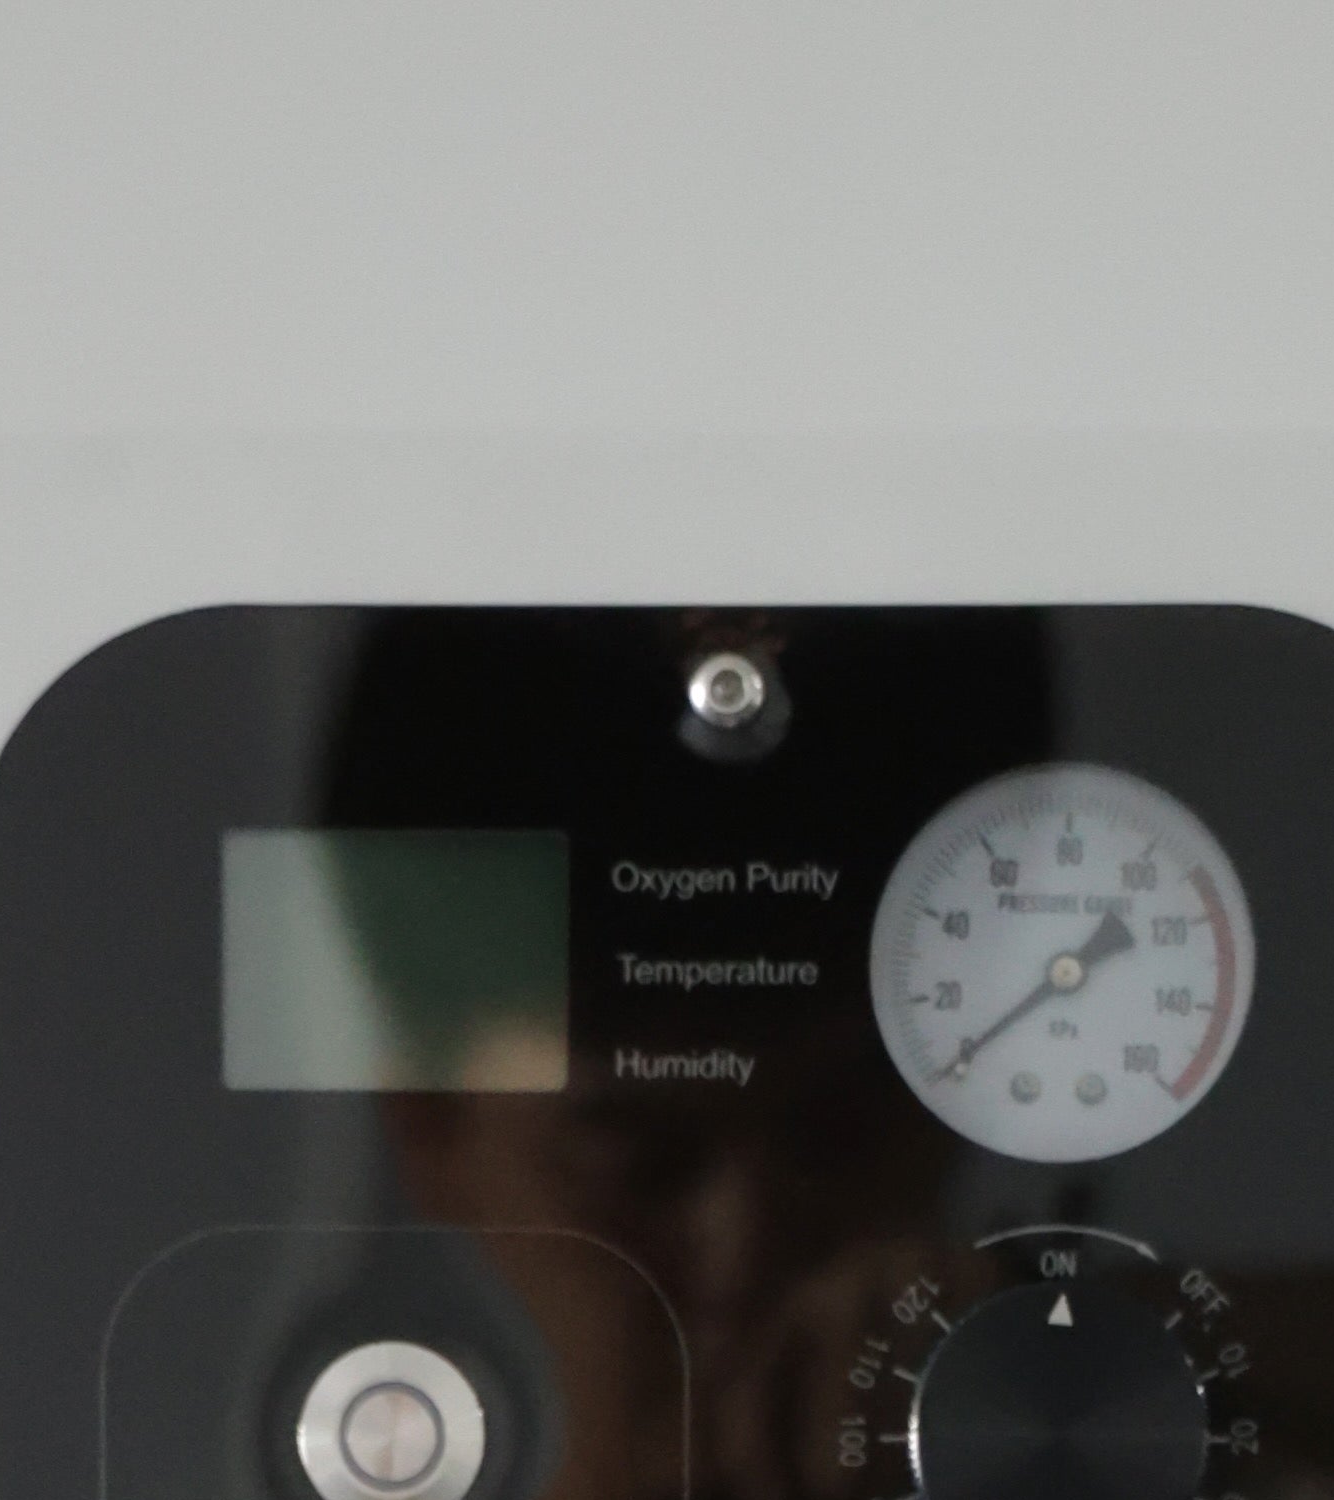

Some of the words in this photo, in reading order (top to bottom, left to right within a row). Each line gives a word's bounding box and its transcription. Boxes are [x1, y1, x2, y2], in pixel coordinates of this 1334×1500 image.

[612, 860, 735, 900] Oxygen
[746, 861, 839, 900] Purity
[616, 953, 820, 992] Temperature
[615, 1049, 755, 1087] Humidity
[1039, 1251, 1077, 1278] ON
[891, 1275, 940, 1325] 120
[1180, 1268, 1231, 1313] OFF
[848, 1338, 890, 1389] 110
[838, 1415, 867, 1468] 100
[1229, 1418, 1259, 1456] 20
